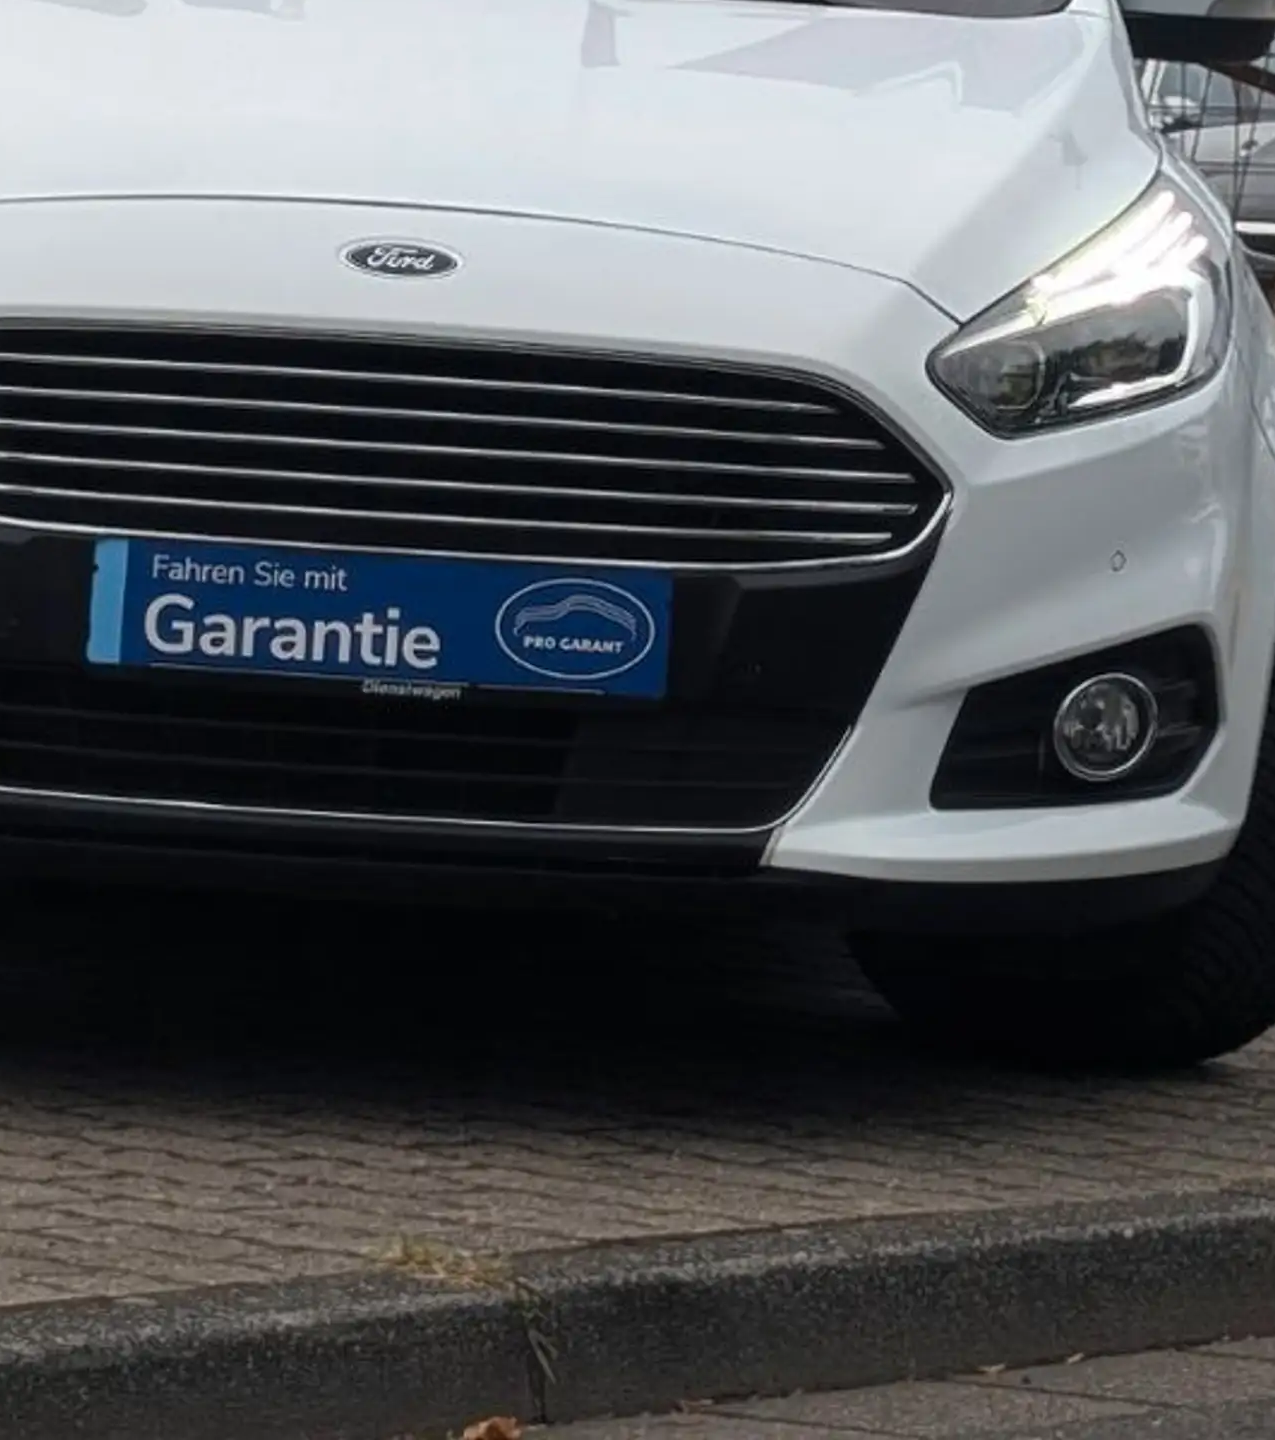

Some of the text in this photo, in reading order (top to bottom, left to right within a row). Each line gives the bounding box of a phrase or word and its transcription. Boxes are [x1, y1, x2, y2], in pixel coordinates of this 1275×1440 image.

[366, 246, 436, 270] Ford
[152, 554, 349, 592] Fahren Sie mit
[143, 592, 442, 670] Garantie
[522, 635, 625, 654] PRO GARANT
